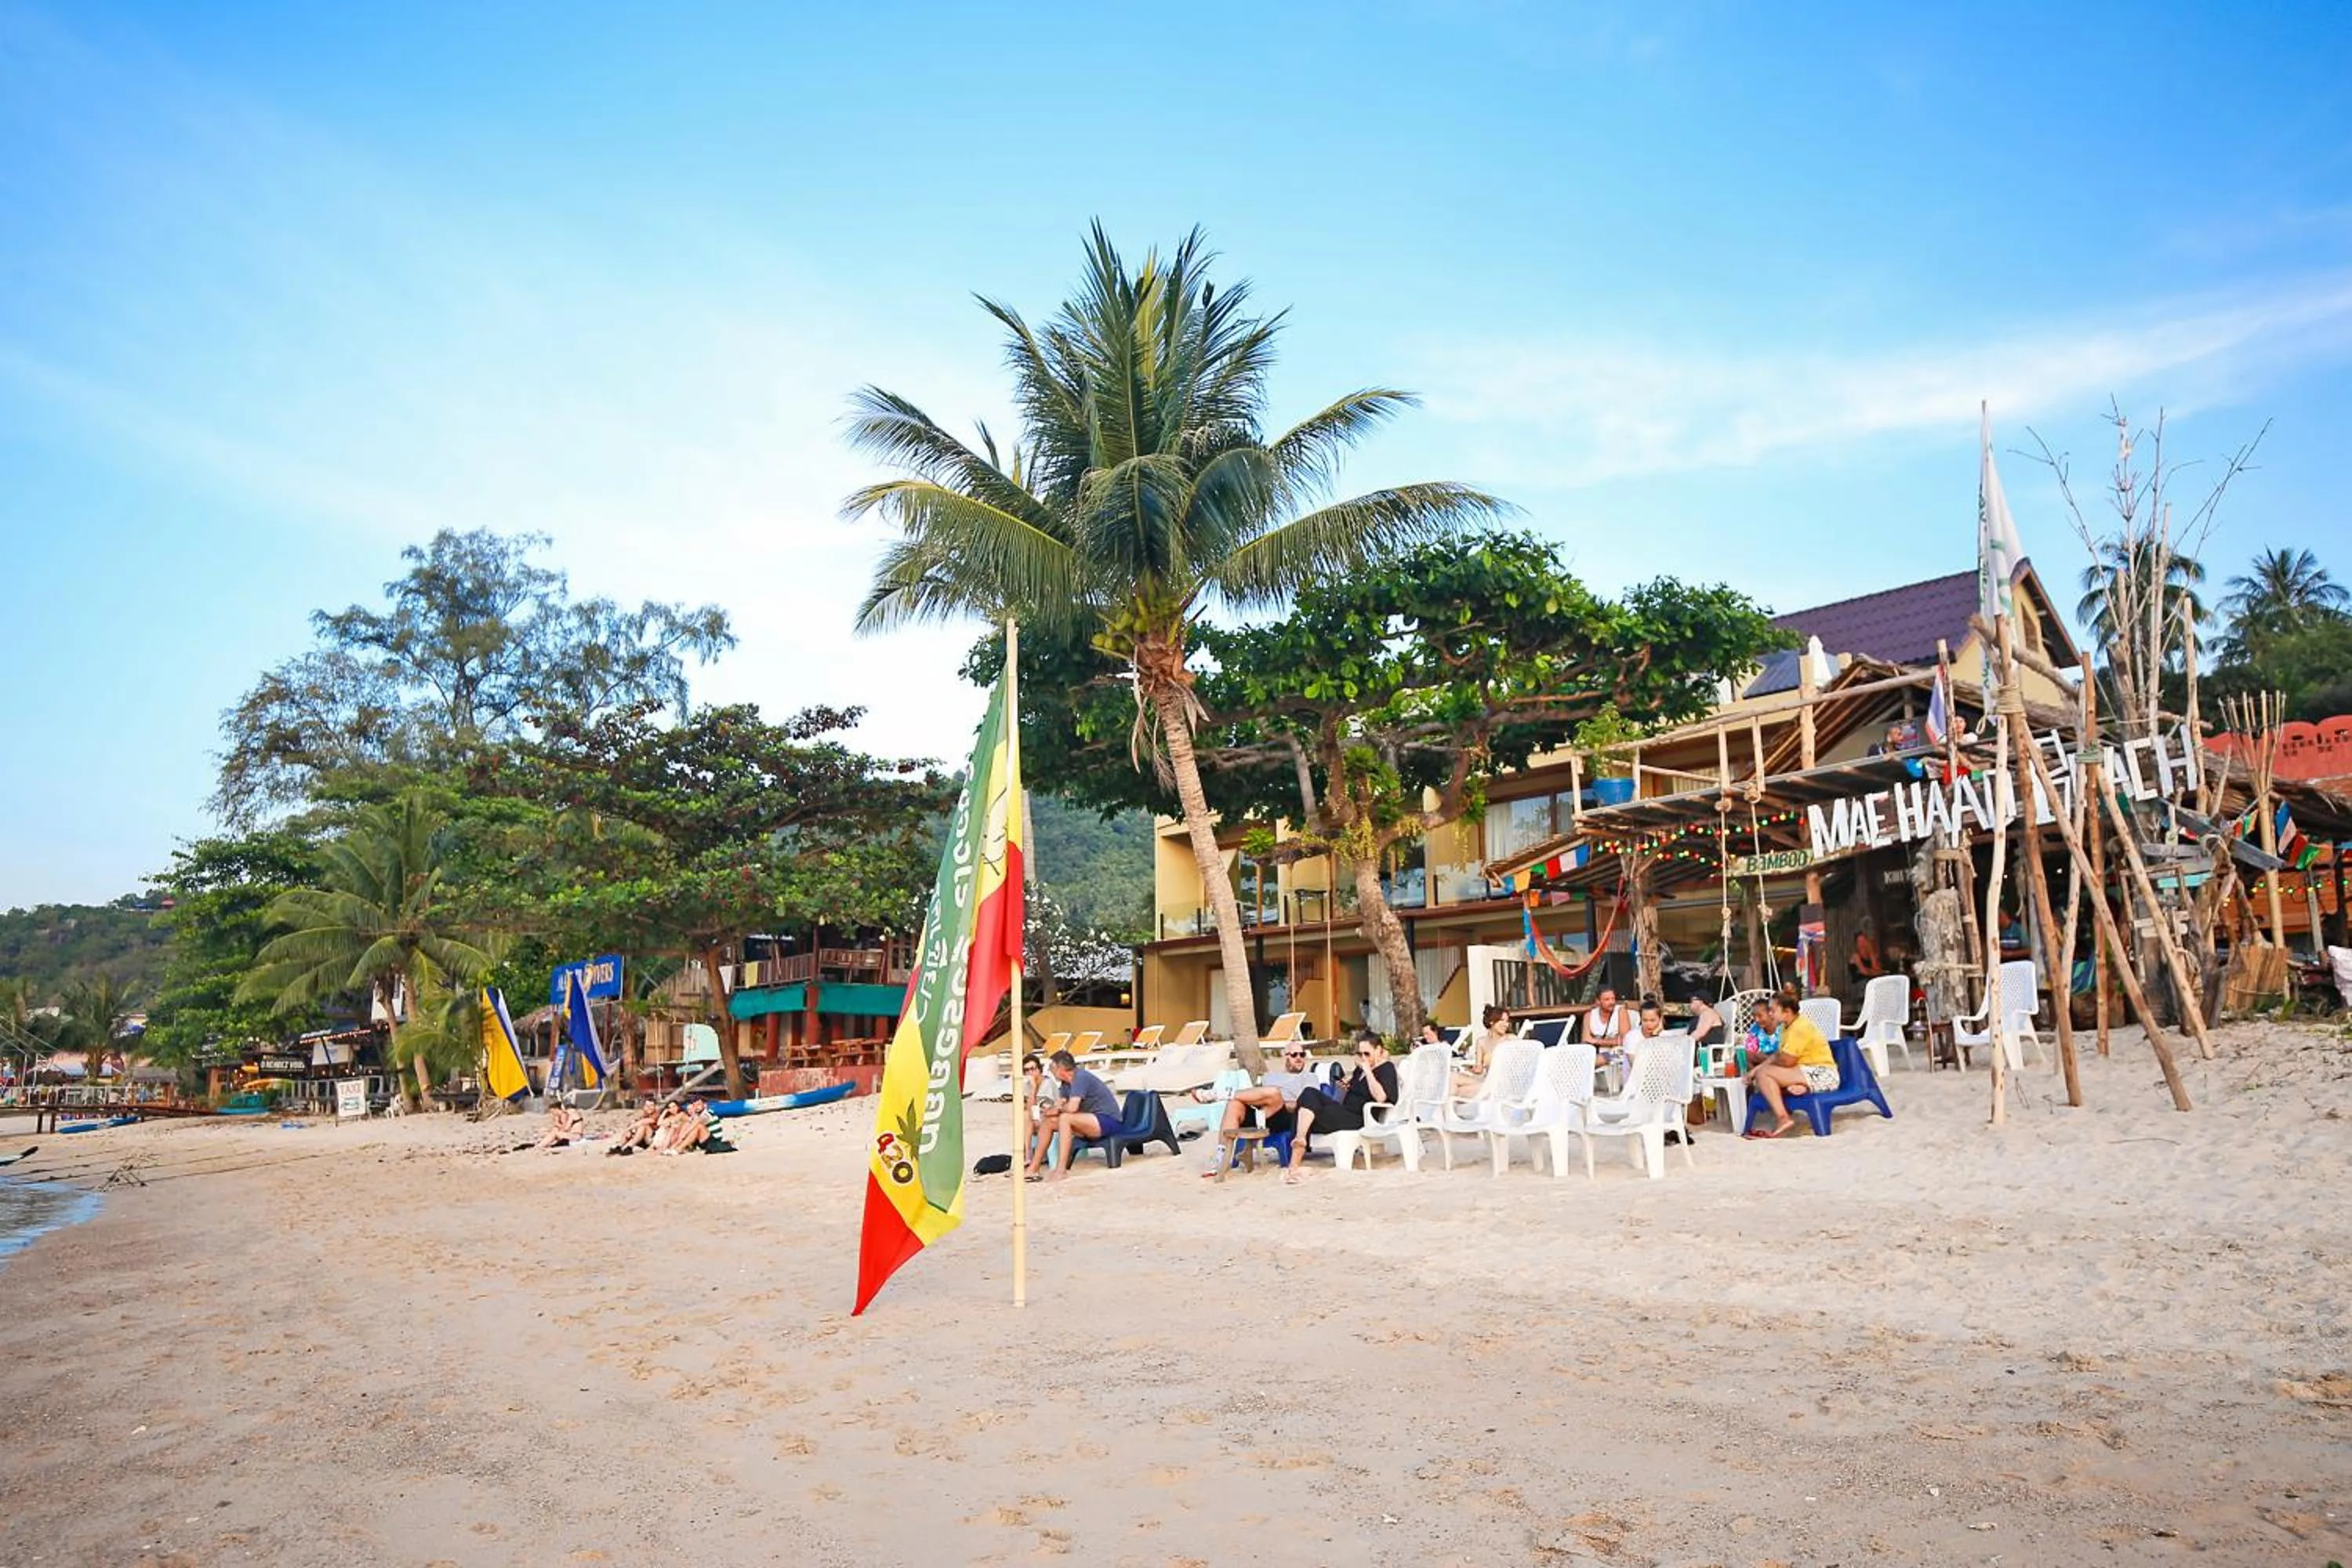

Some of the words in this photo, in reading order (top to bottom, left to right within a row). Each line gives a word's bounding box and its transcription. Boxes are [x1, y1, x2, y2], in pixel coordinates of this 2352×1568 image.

[1808, 791, 1892, 859] MAE
[1894, 769, 2017, 848] HAAD
[1747, 850, 1807, 872] BAMBOO
[339, 1083, 362, 1095] TAXI
[877, 1133, 913, 1184] 420
